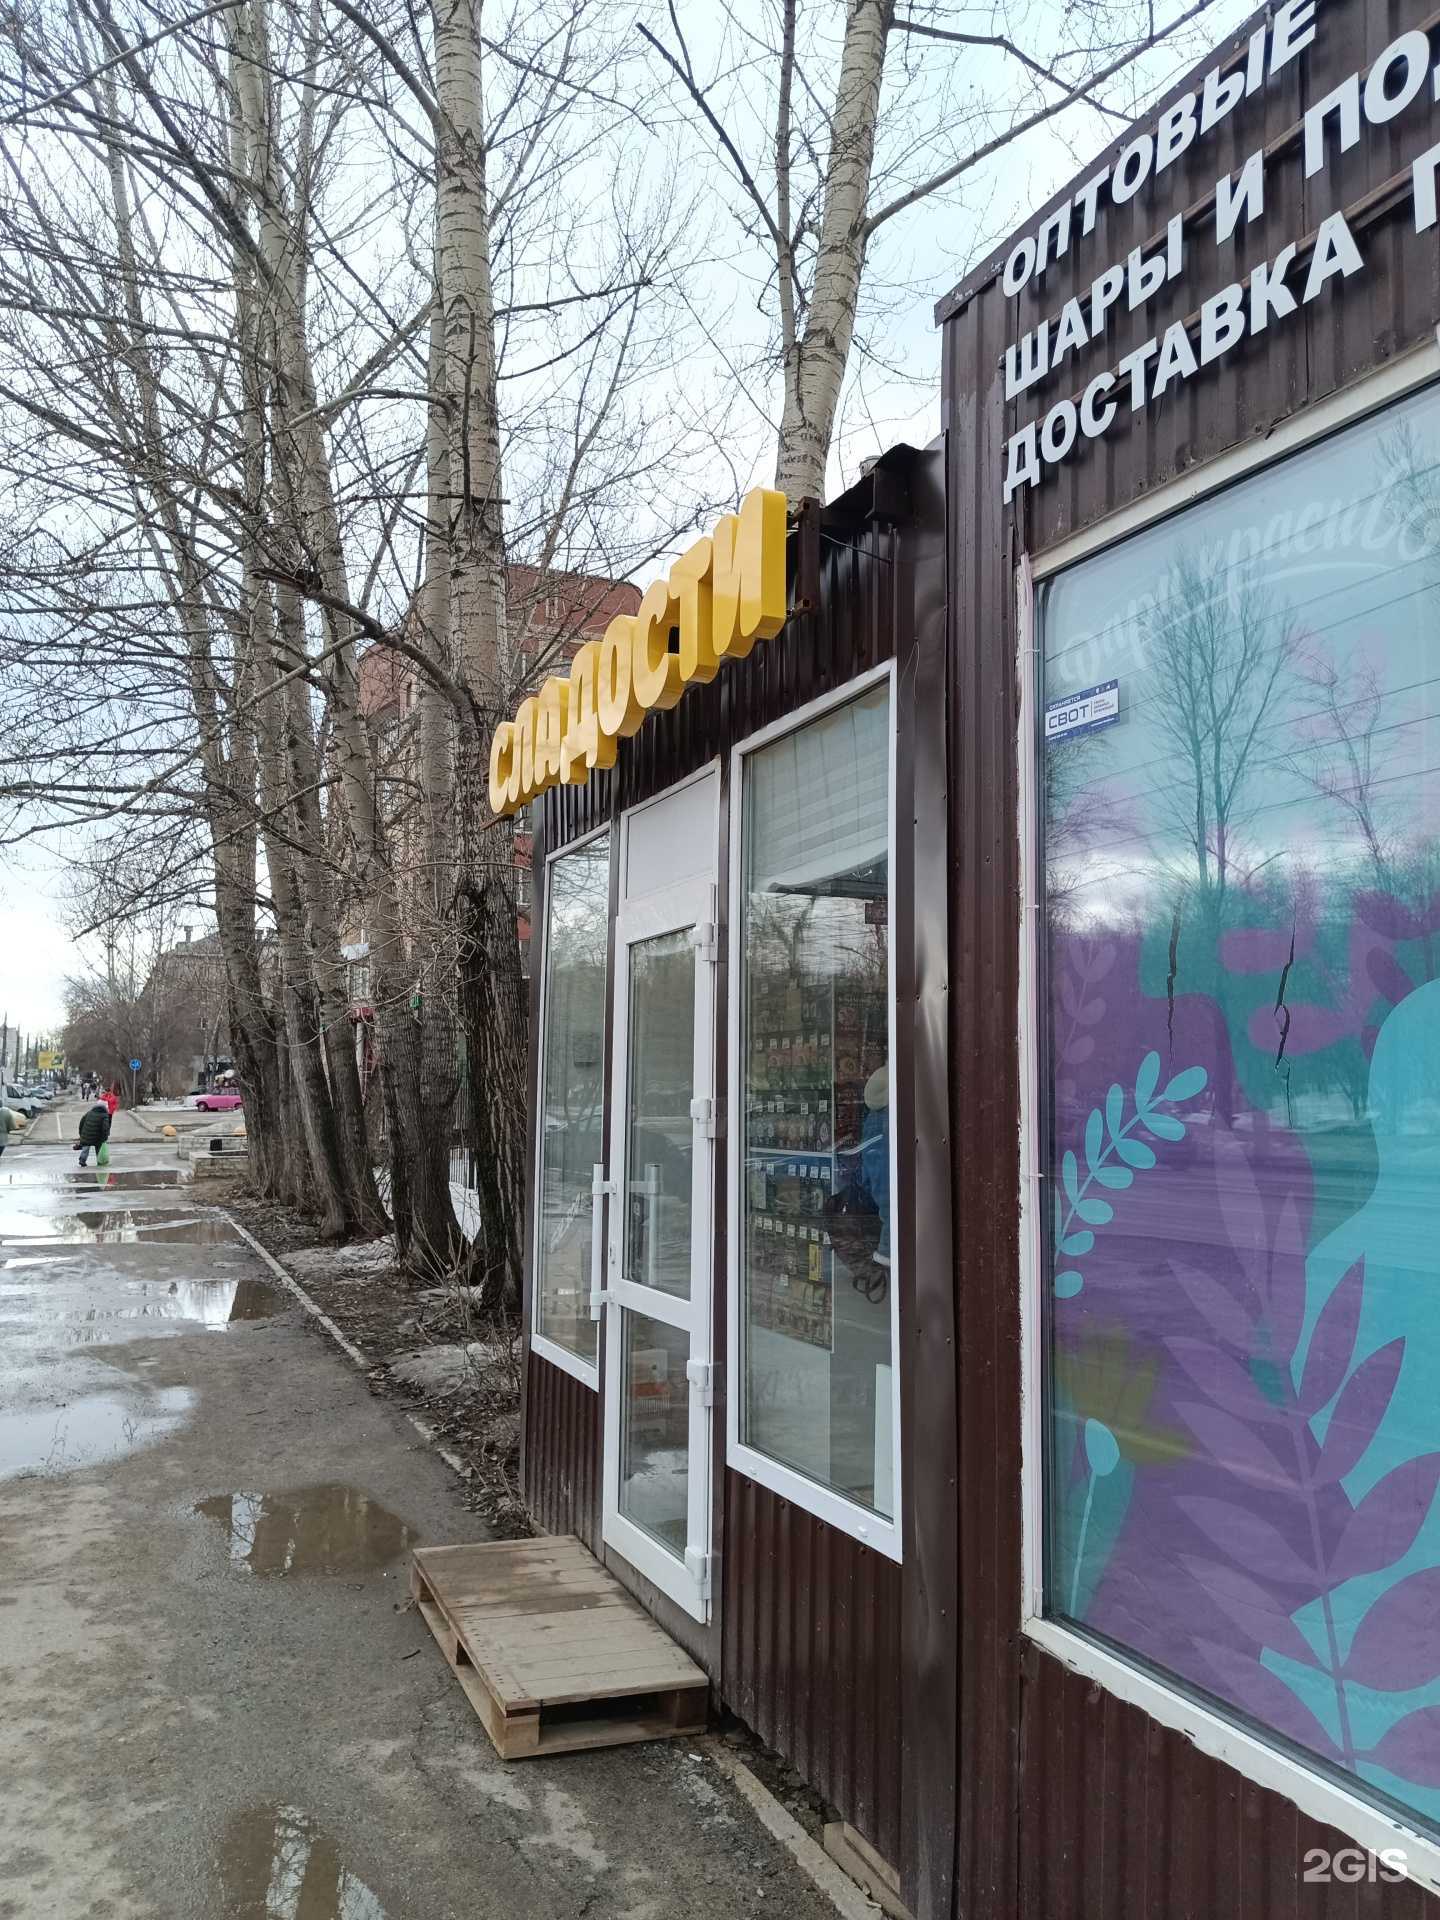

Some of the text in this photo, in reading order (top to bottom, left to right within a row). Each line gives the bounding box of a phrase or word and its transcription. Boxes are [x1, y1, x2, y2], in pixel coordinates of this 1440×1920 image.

[1003, 0, 1317, 298] ОПТОВЫЕ
[1005, 213, 1184, 402] ШАРЫ
[1216, 149, 1265, 246] И
[1304, 30, 1440, 180] ПО
[1003, 210, 1365, 506] ДОСТАВКА
[488, 486, 787, 815] СЛАДОСТИ
